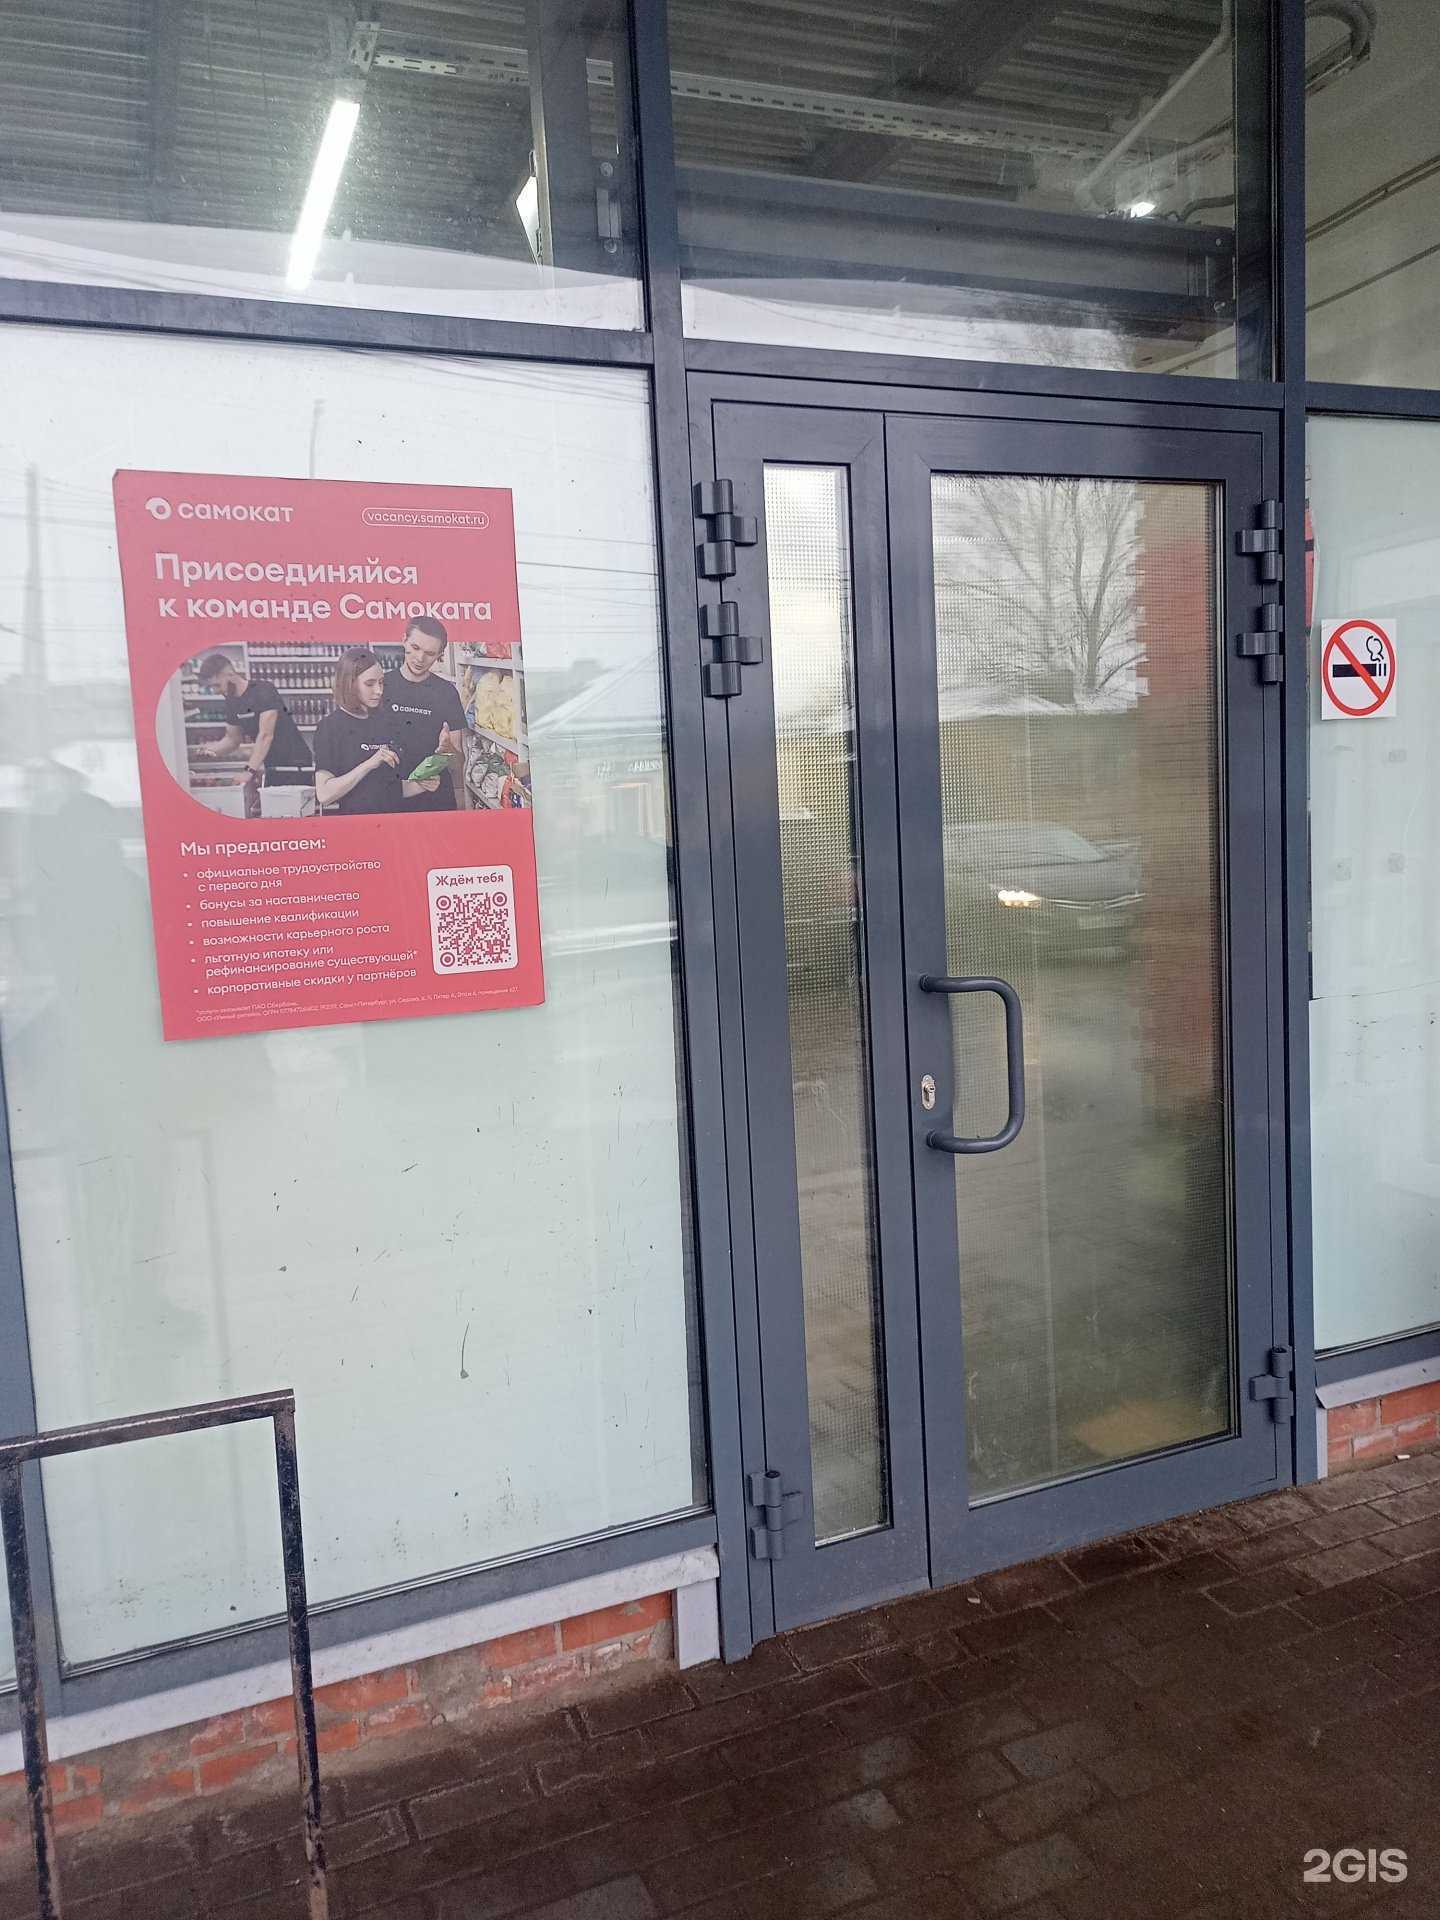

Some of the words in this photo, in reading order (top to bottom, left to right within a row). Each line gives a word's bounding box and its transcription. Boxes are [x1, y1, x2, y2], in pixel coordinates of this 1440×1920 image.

[178, 503, 294, 522] самокат
[367, 511, 485, 526] vacancy.samokat.ru
[155, 552, 418, 588] Присоединяйся
[158, 598, 181, 618] к
[187, 598, 331, 622] команде
[339, 593, 492, 620] Самоката
[180, 841, 210, 856] Мы
[215, 838, 326, 857] предлагаем:
[196, 867, 280, 881] официальное
[281, 859, 381, 876] трудоустройство
[435, 874, 474, 887] Ждём
[476, 871, 504, 884] тебя
[198, 884, 206, 892] с
[208, 880, 258, 893] первого
[260, 879, 282, 889] дня
[200, 899, 246, 911] бонусы
[248, 899, 263, 907] за
[265, 891, 360, 905] наставничество
[201, 914, 271, 928] повышение
[274, 908, 360, 924] квалификации
[203, 931, 284, 946] возможности
[286, 926, 354, 941] карьерного
[356, 923, 390, 937] роста
[205, 951, 260, 964] льготную
[263, 947, 310, 959] ипотеку
[313, 946, 334, 955] или
[206, 959, 325, 979] рефинансирование
[207, 978, 301, 996] корпоративные
[303, 975, 345, 986] скидки
[347, 974, 354, 985] у
[356, 968, 417, 983] партнёров
